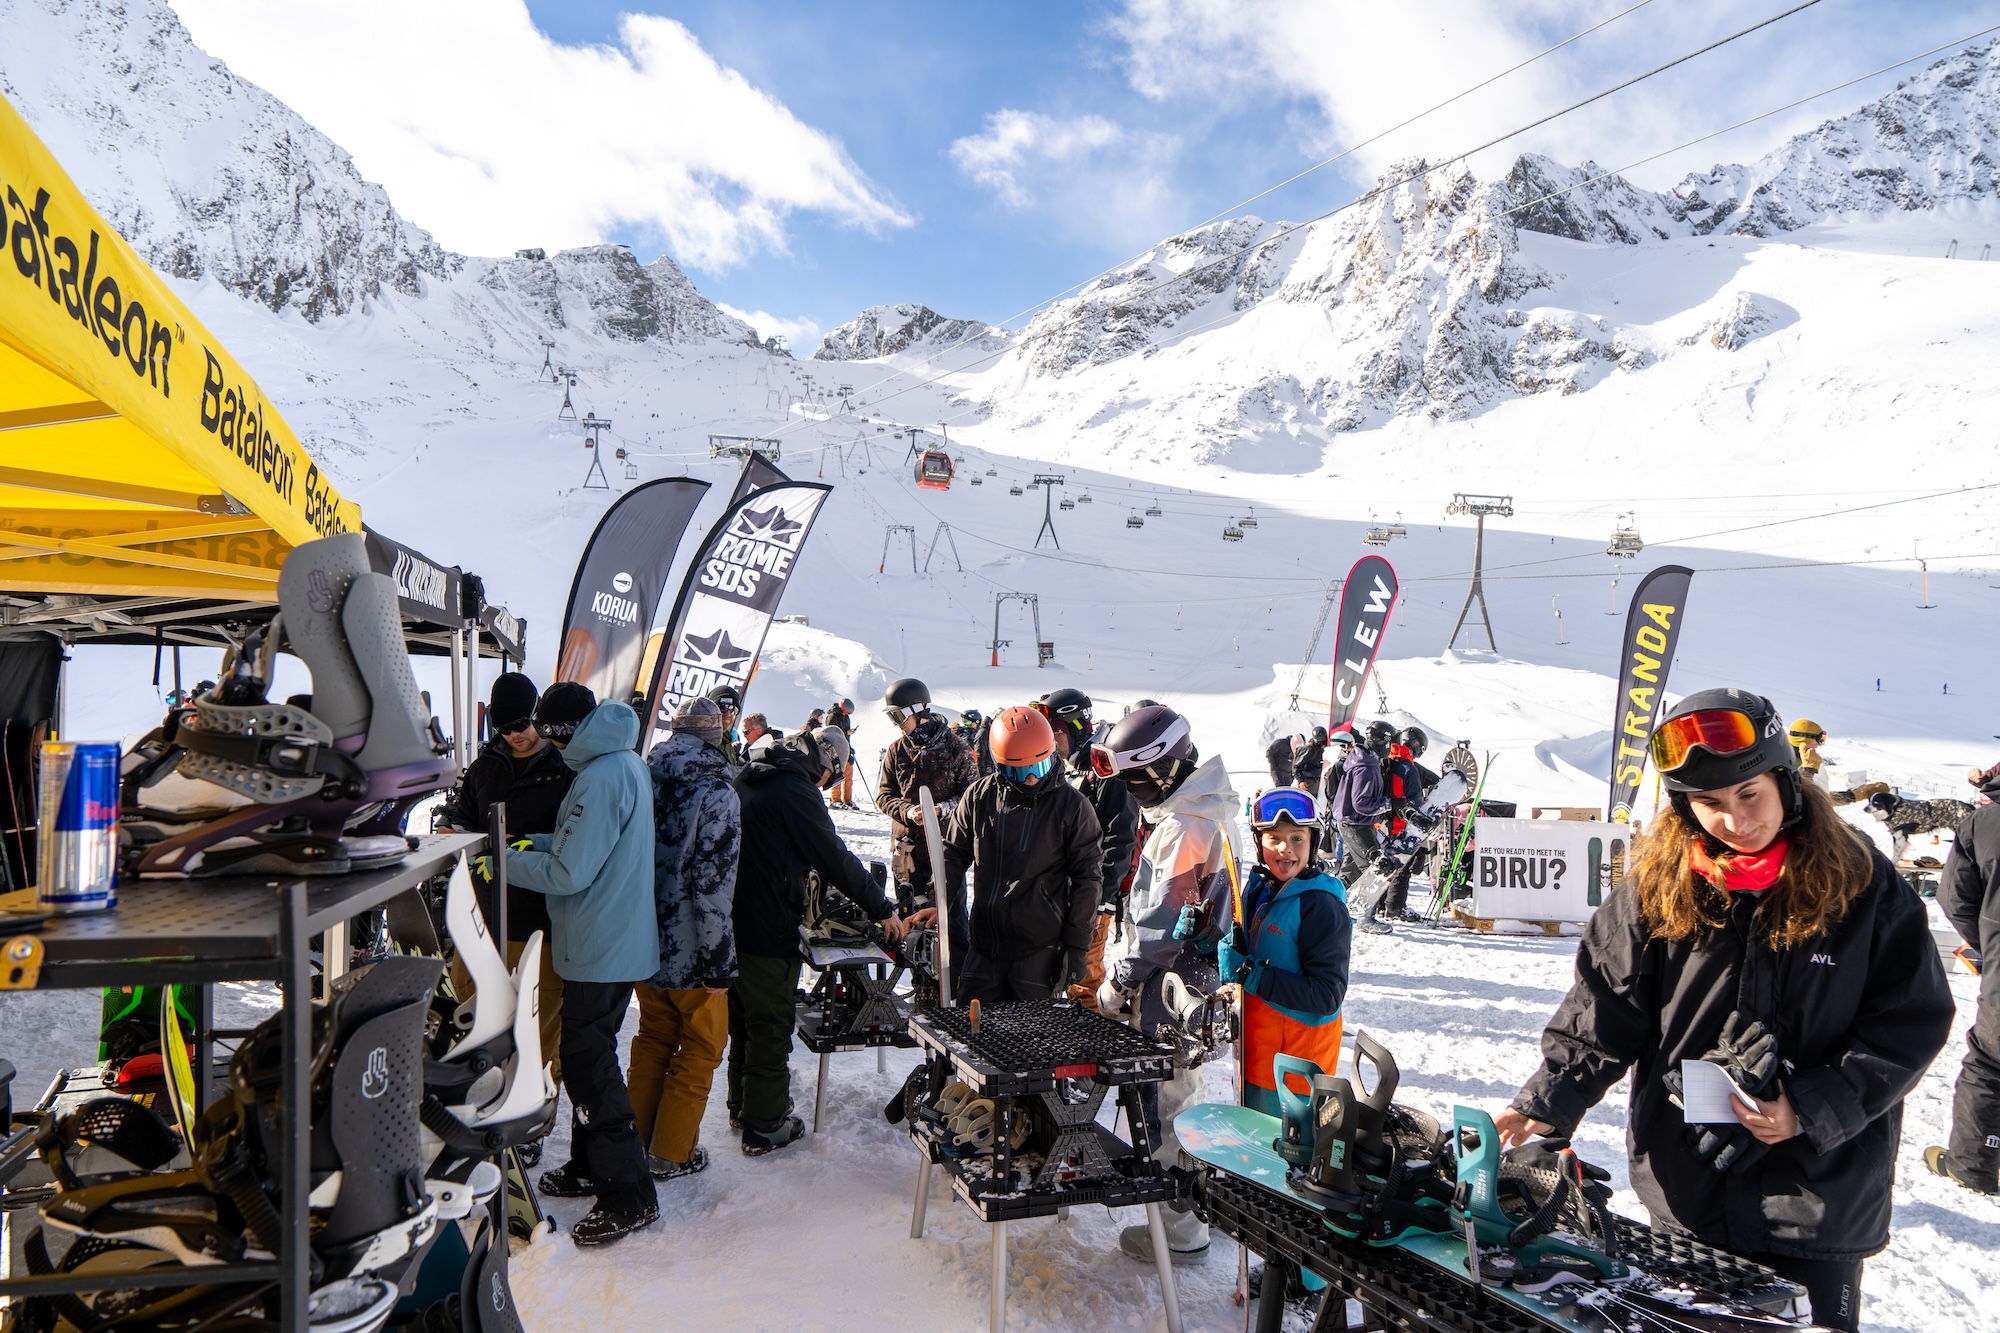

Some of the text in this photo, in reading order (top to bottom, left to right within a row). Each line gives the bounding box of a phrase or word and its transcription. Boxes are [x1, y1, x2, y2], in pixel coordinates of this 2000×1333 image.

[200, 343, 293, 505] Bataleon
[304, 462, 350, 537] Batale
[711, 532, 795, 580] ROME
[700, 558, 761, 599] SDS
[591, 591, 638, 623] KORUA
[597, 614, 627, 627] SHAPES
[1336, 574, 1392, 706] CLEW
[1615, 603, 1675, 787] STRANDA
[1493, 847, 1505, 855] YOU
[1506, 848, 1526, 856] READY
[1536, 849, 1552, 857] MEET
[1554, 849, 1566, 857] THE
[1480, 856, 1567, 890] BIRU?
[1810, 953, 1836, 966] AVL
[63, 1199, 87, 1213] Astro
[1836, 1283, 1850, 1317] burton
